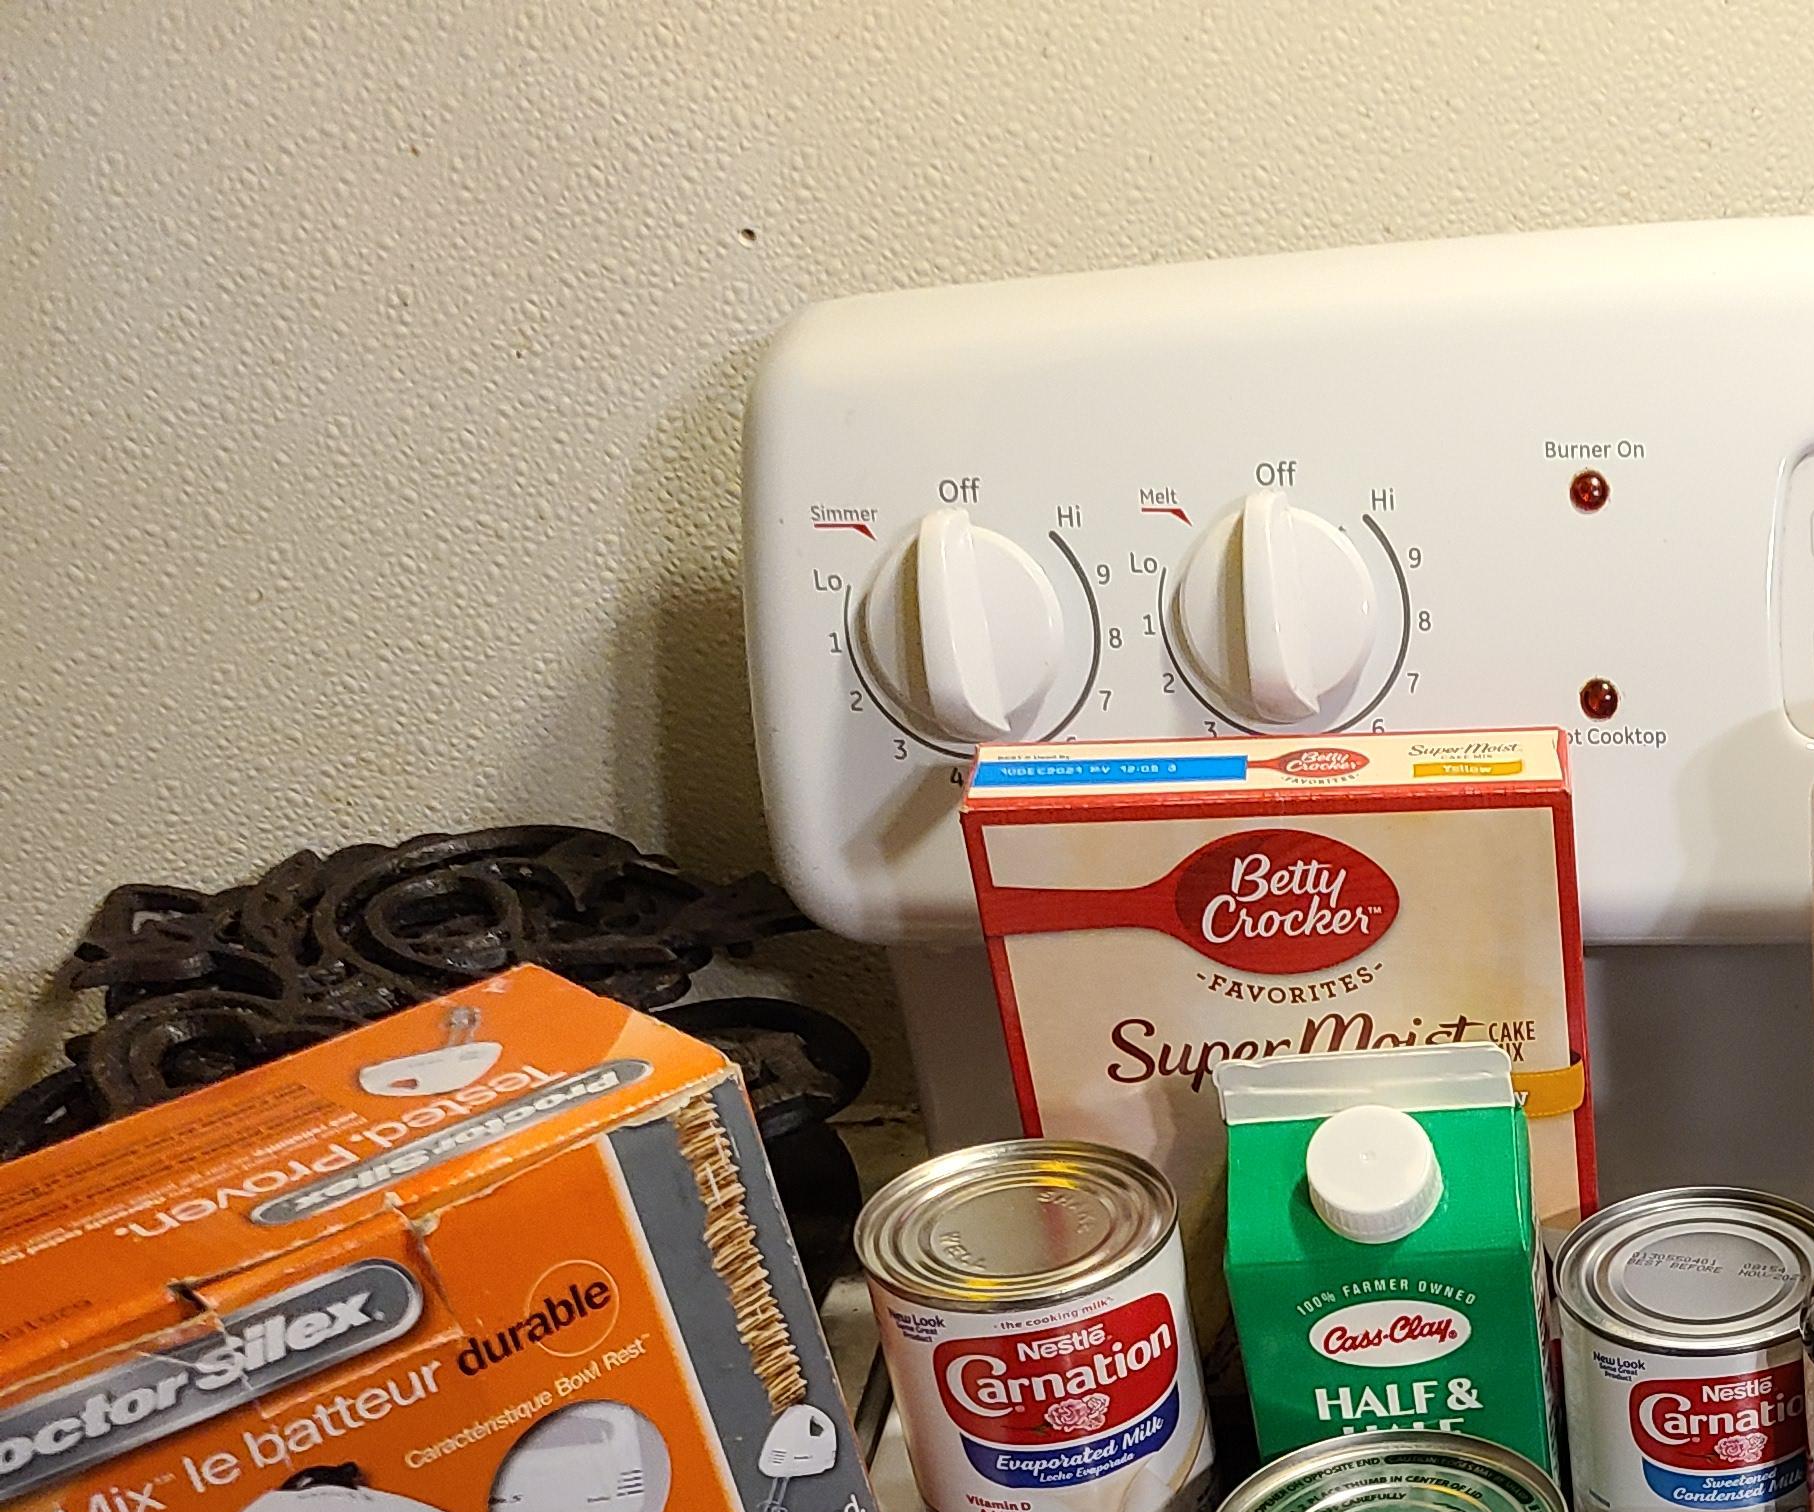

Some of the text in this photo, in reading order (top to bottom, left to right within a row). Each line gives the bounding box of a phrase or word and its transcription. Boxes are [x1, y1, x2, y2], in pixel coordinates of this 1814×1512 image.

[1544, 440, 1646, 459] Burner On
[1255, 461, 1297, 487] Off
[938, 477, 981, 504] Off
[1139, 487, 1179, 505] Melt
[1371, 488, 1396, 512] Hi
[810, 505, 878, 523] Simmer
[1056, 504, 1082, 528] Hi
[1129, 552, 1158, 574] Lo
[1408, 547, 1422, 568] 9
[812, 568, 843, 592] Lo
[1096, 563, 1111, 585] 9
[1417, 610, 1432, 632] 8
[1108, 627, 1123, 649] 8
[1586, 726, 1668, 748] Cooktop
[1231, 854, 1346, 905] Betty
[1488, 1020, 1536, 1042] CAKE
[1296, 1278, 1477, 1316] 100% FARMER OWNED
[912, 1315, 946, 1329] Look
[1025, 1309, 1079, 1330] cooking
[945, 1323, 1173, 1417] Carnation
[1618, 1357, 1646, 1371] Look
[181, 1281, 613, 1493] le batteur durable
[553, 1360, 602, 1397] Bowl
[1314, 1377, 1485, 1421] HALF &
[996, 1415, 1164, 1477] Evaporated Milk
[1701, 1469, 1777, 1490] Sweetened
[966, 1494, 1019, 1511] Vitamin
[1673, 1482, 1765, 1503] Condensed
